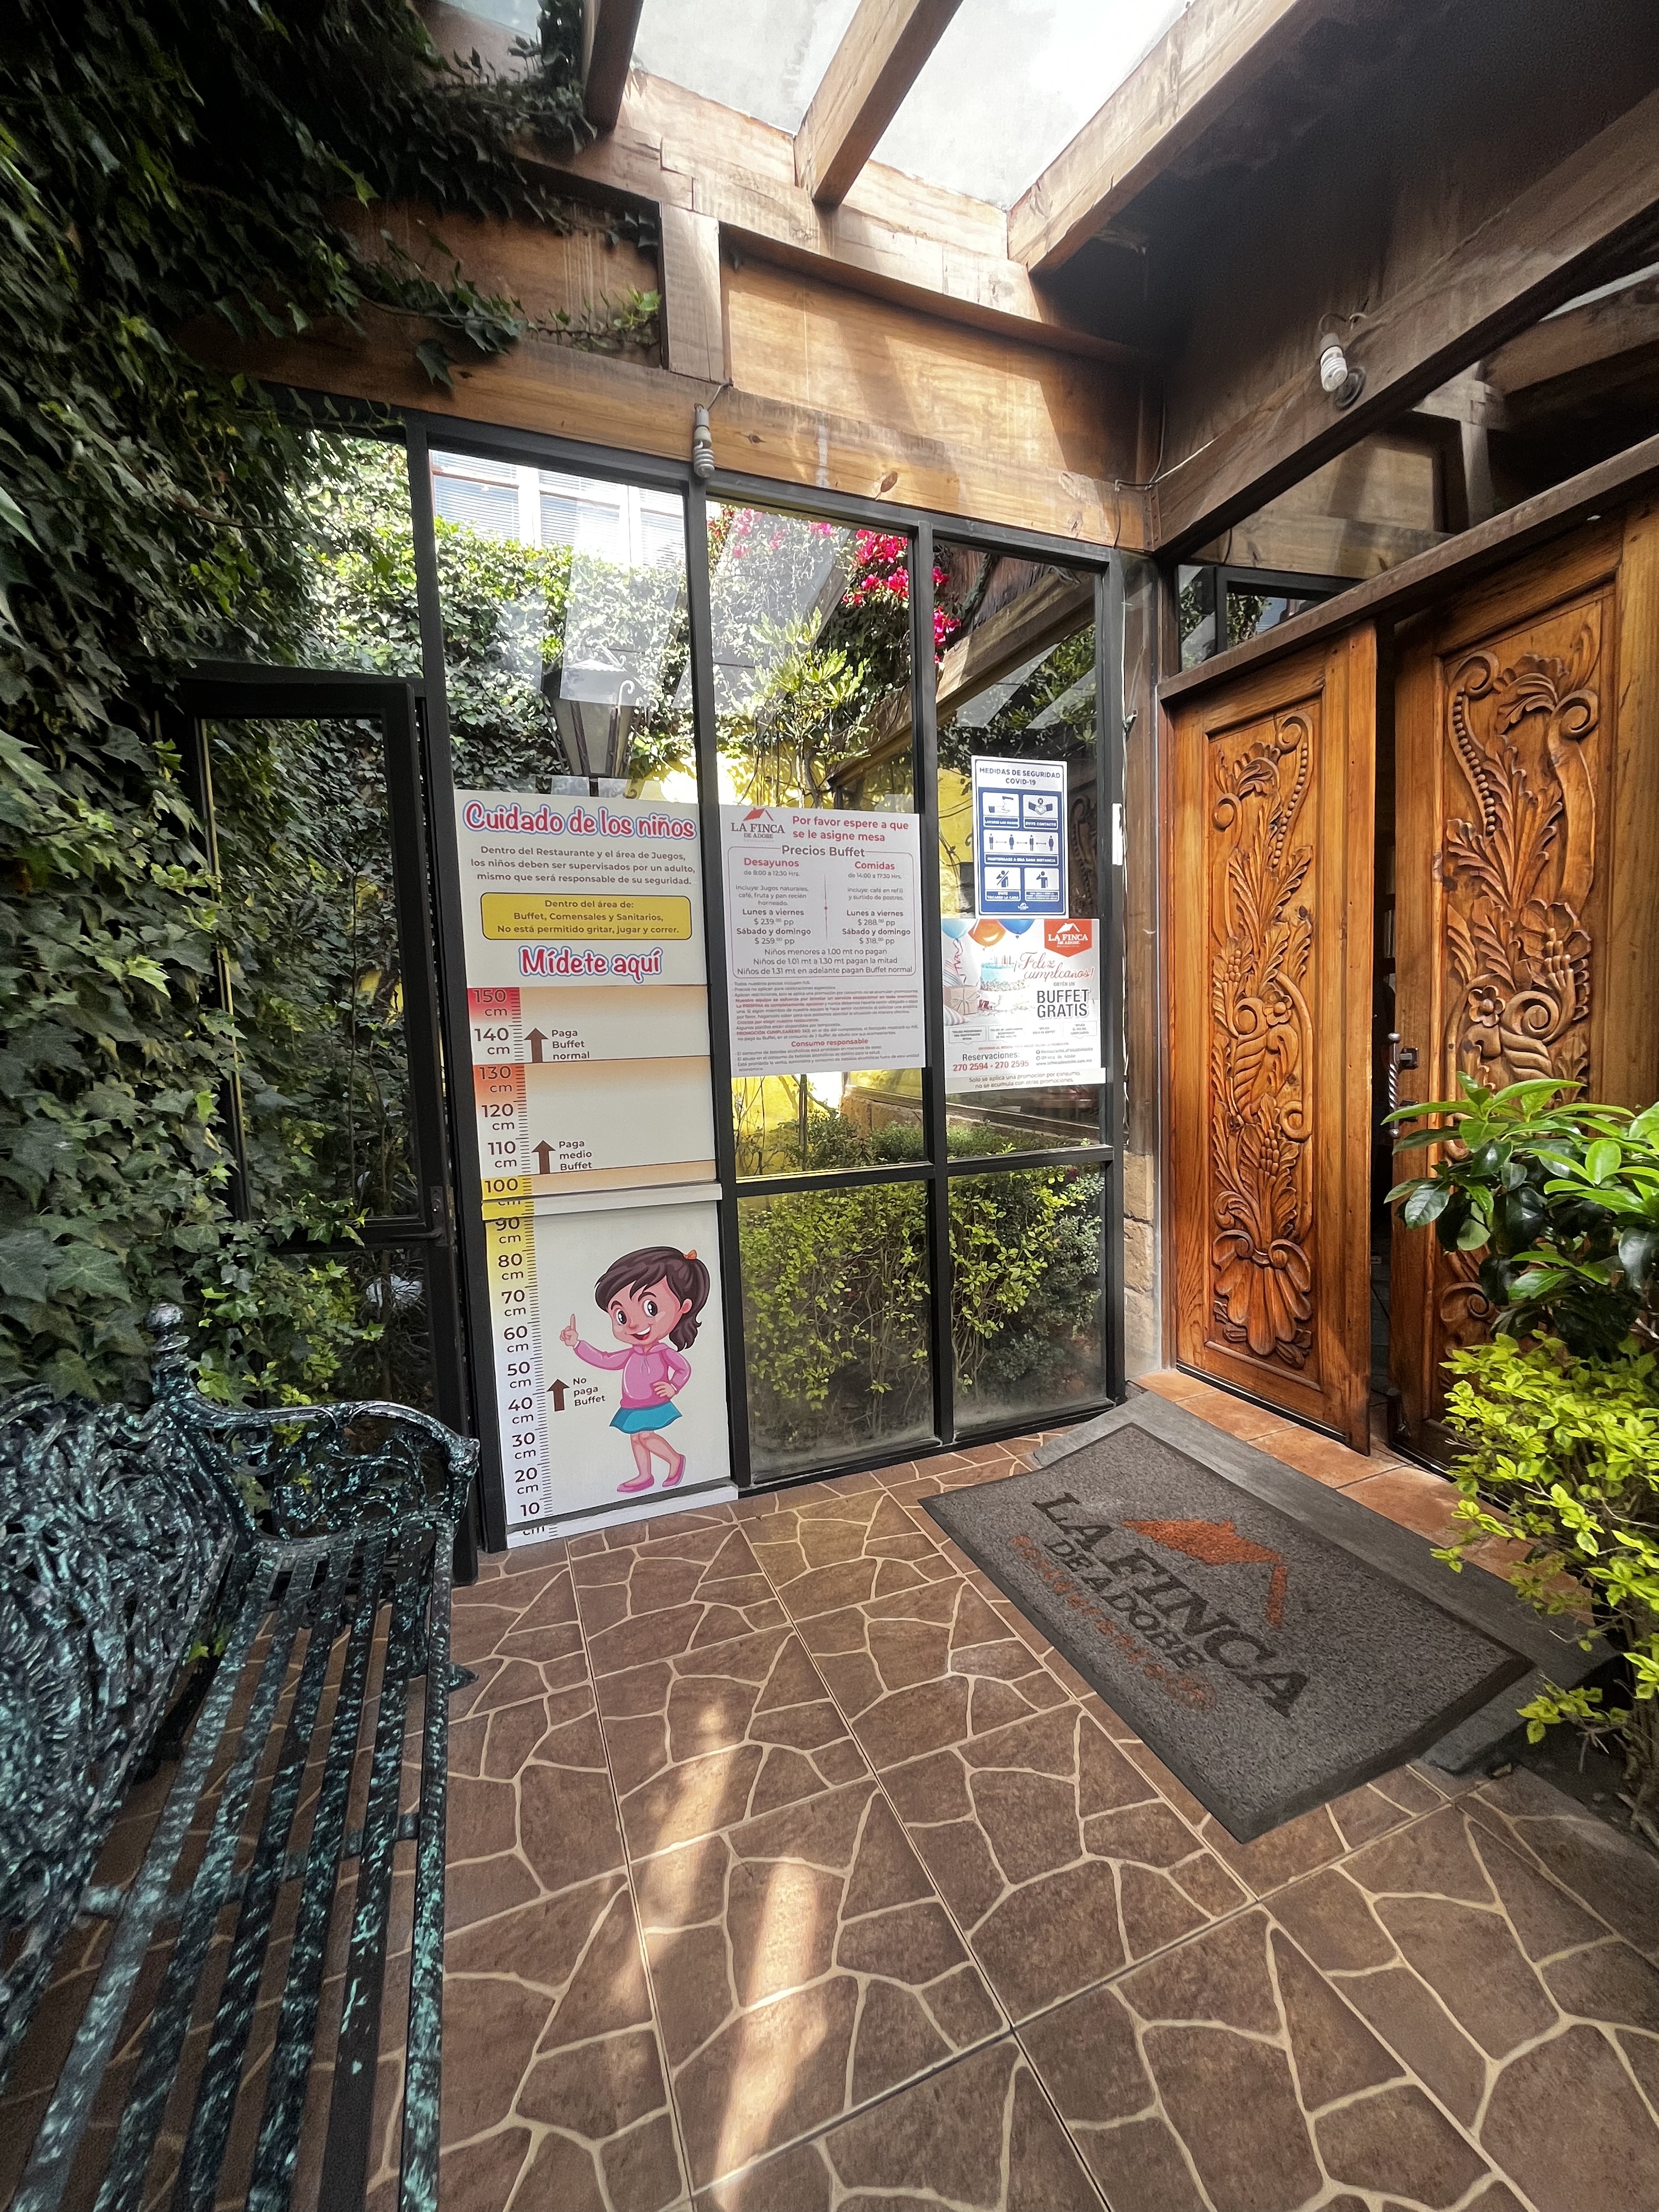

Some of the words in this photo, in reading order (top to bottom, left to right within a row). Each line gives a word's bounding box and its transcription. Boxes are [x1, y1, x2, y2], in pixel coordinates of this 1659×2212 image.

[464, 802, 564, 832] Cuidado
[568, 805, 596, 834] de
[601, 809, 633, 836] los
[637, 813, 696, 838] niños
[793, 816, 810, 825] Por
[814, 816, 840, 827] favor
[844, 819, 878, 829] espere
[889, 822, 909, 831] que
[731, 822, 746, 833] LA
[750, 823, 785, 834] FINCA
[808, 830, 817, 839] le
[821, 831, 855, 842] asigne
[858, 833, 885, 842] mesa
[481, 845, 516, 855] Dentro
[518, 847, 533, 855] del
[537, 848, 595, 857] Restaurante
[597, 850, 603, 859] y
[605, 850, 613, 859] el
[616, 850, 635, 859] área
[638, 851, 650, 859] de
[651, 851, 686, 861] Juegos,
[782, 845, 826, 856] Precios
[830, 847, 865, 857] Buffet
[471, 859, 486, 867] los
[488, 859, 516, 868] niños
[518, 860, 549, 869] deben
[569, 862, 630, 872] supervisados
[633, 864, 648, 873] por
[664, 865, 696, 874] adulto,
[744, 857, 799, 868] Desayunos
[855, 861, 895, 870] Comidas
[477, 872, 511, 881] mismo
[514, 874, 533, 883] que
[535, 873, 556, 882] será
[558, 874, 616, 884] responsable
[645, 876, 692, 885] seguridad.
[580, 900, 595, 909] del
[597, 900, 617, 909] área
[619, 901, 634, 909] de:
[514, 912, 547, 921] Buffet,
[550, 913, 606, 922] Comensales
[617, 913, 664, 922] Sanitarios,
[497, 925, 511, 933] No
[514, 925, 534, 933] está
[537, 925, 584, 934] permitido
[587, 925, 615, 935] gritar,
[617, 926, 641, 935] jugar
[643, 927, 648, 935] y
[651, 926, 679, 934] correr.
[775, 927, 811, 936] domingo
[877, 928, 911, 936] domingo
[521, 947, 608, 975] Mídete
[612, 948, 661, 981] aquí
[473, 990, 506, 1003] 150
[1037, 989, 1089, 1003] BUFFET
[484, 1008, 507, 1017] cm
[1037, 1003, 1087, 1018] GRATIS
[475, 1028, 509, 1041] 140
[551, 1029, 578, 1038] Paga
[552, 1040, 585, 1049] Buffet
[826, 1038, 868, 1047] responsable
[487, 1046, 510, 1055] cm
[553, 1052, 590, 1060] normal
[479, 1066, 511, 1080] 130
[482, 1104, 514, 1118] 120
[492, 1121, 515, 1130] cm
[488, 1141, 516, 1155] 110
[559, 1139, 585, 1148] Paga
[560, 1150, 592, 1159] medio
[495, 1159, 517, 1168] cm
[560, 1161, 592, 1171] Buffet
[484, 1178, 518, 1193] 100
[495, 1217, 520, 1232] 90
[499, 1235, 521, 1244] cm
[498, 1253, 522, 1268] 80
[501, 1272, 524, 1280] cm
[501, 1289, 525, 1305] 70
[504, 1307, 526, 1317] cm
[504, 1325, 528, 1340] 60
[507, 1343, 529, 1352] cm
[507, 1361, 531, 1376] 50
[510, 1379, 531, 1389] cm
[574, 1386, 599, 1397] paga
[508, 1397, 533, 1412] 40
[574, 1395, 605, 1407] Buffet
[512, 1415, 534, 1424] cm
[512, 1432, 535, 1447] 30
[515, 1450, 536, 1459] cm
[515, 1467, 538, 1483] 20
[517, 1485, 538, 1494] cm
[520, 1502, 540, 1516] 10
[1031, 1492, 1116, 1553] LA
[1099, 1548, 1309, 1718] FINCA
[1044, 1539, 1092, 1573] DE
[1081, 1575, 1209, 1669] ADOBE
